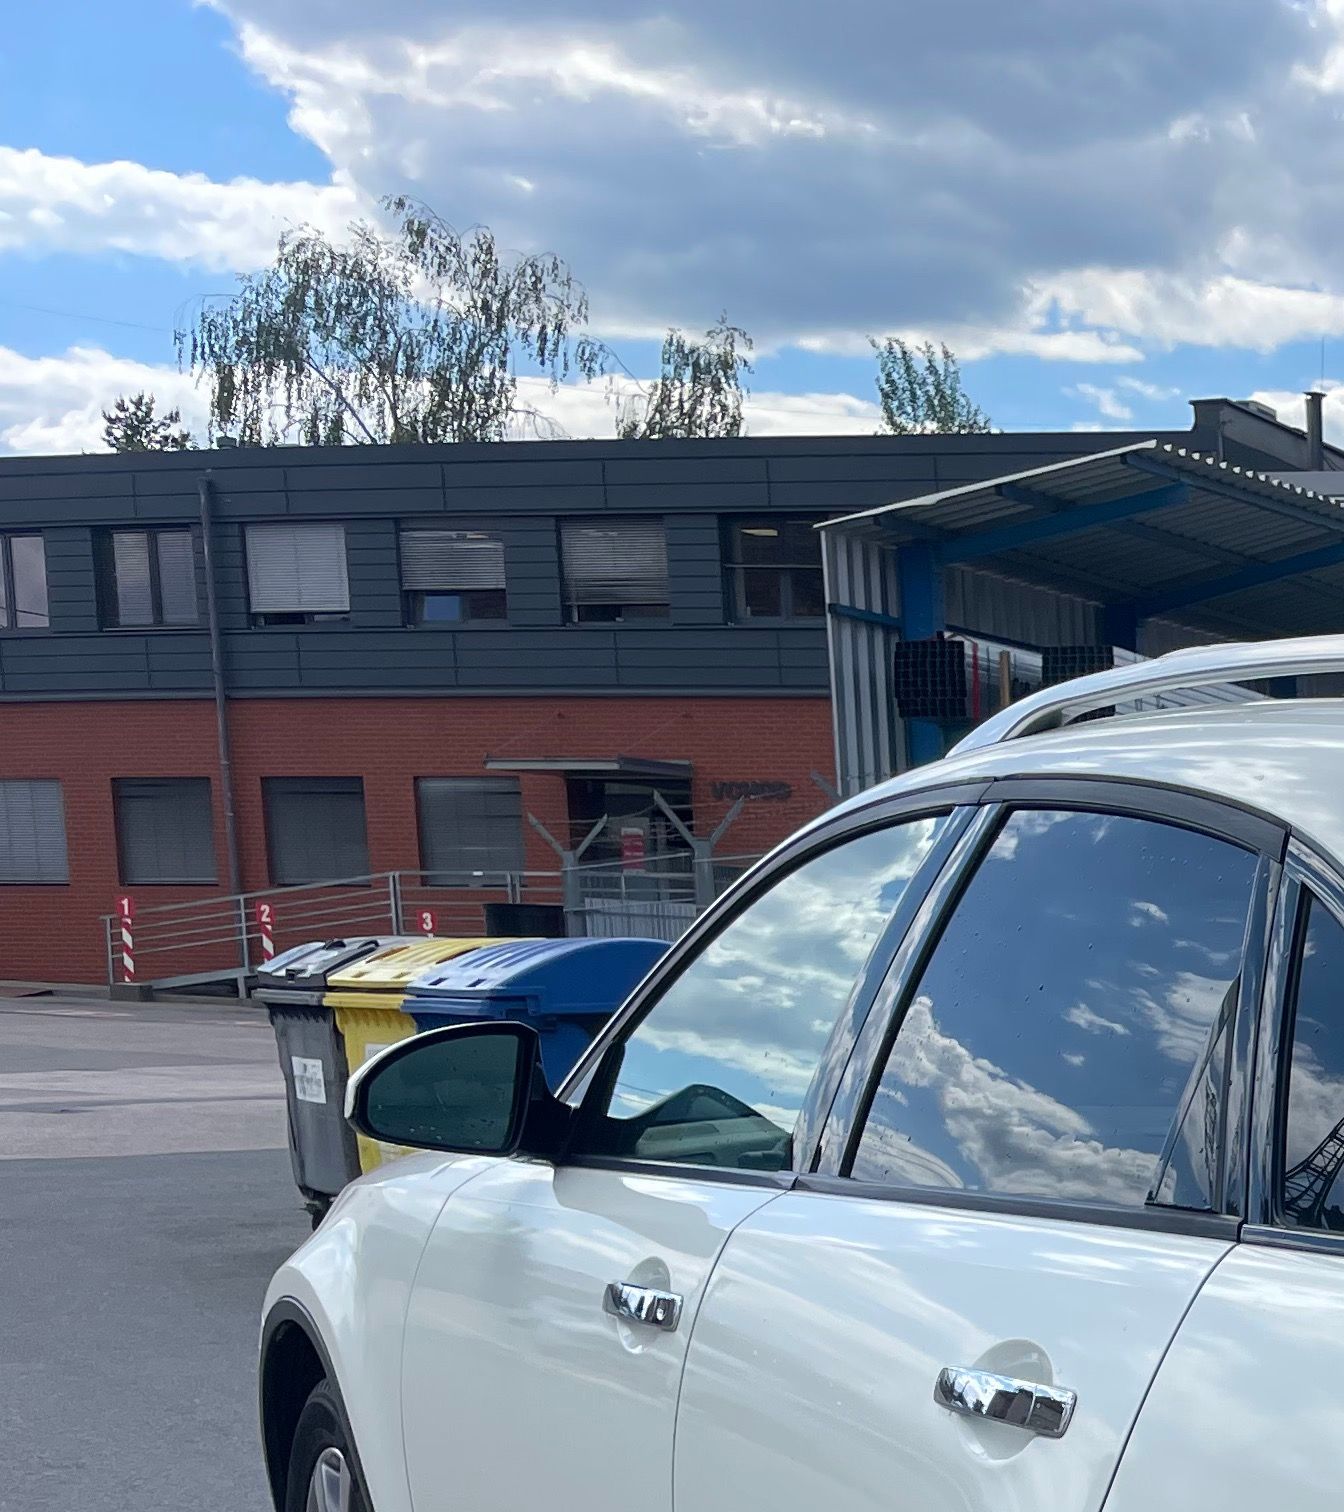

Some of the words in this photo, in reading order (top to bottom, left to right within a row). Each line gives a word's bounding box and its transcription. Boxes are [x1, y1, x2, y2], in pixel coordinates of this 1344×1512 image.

[121, 898, 129, 915] 1
[260, 904, 271, 922] 2
[422, 912, 433, 930] 3
